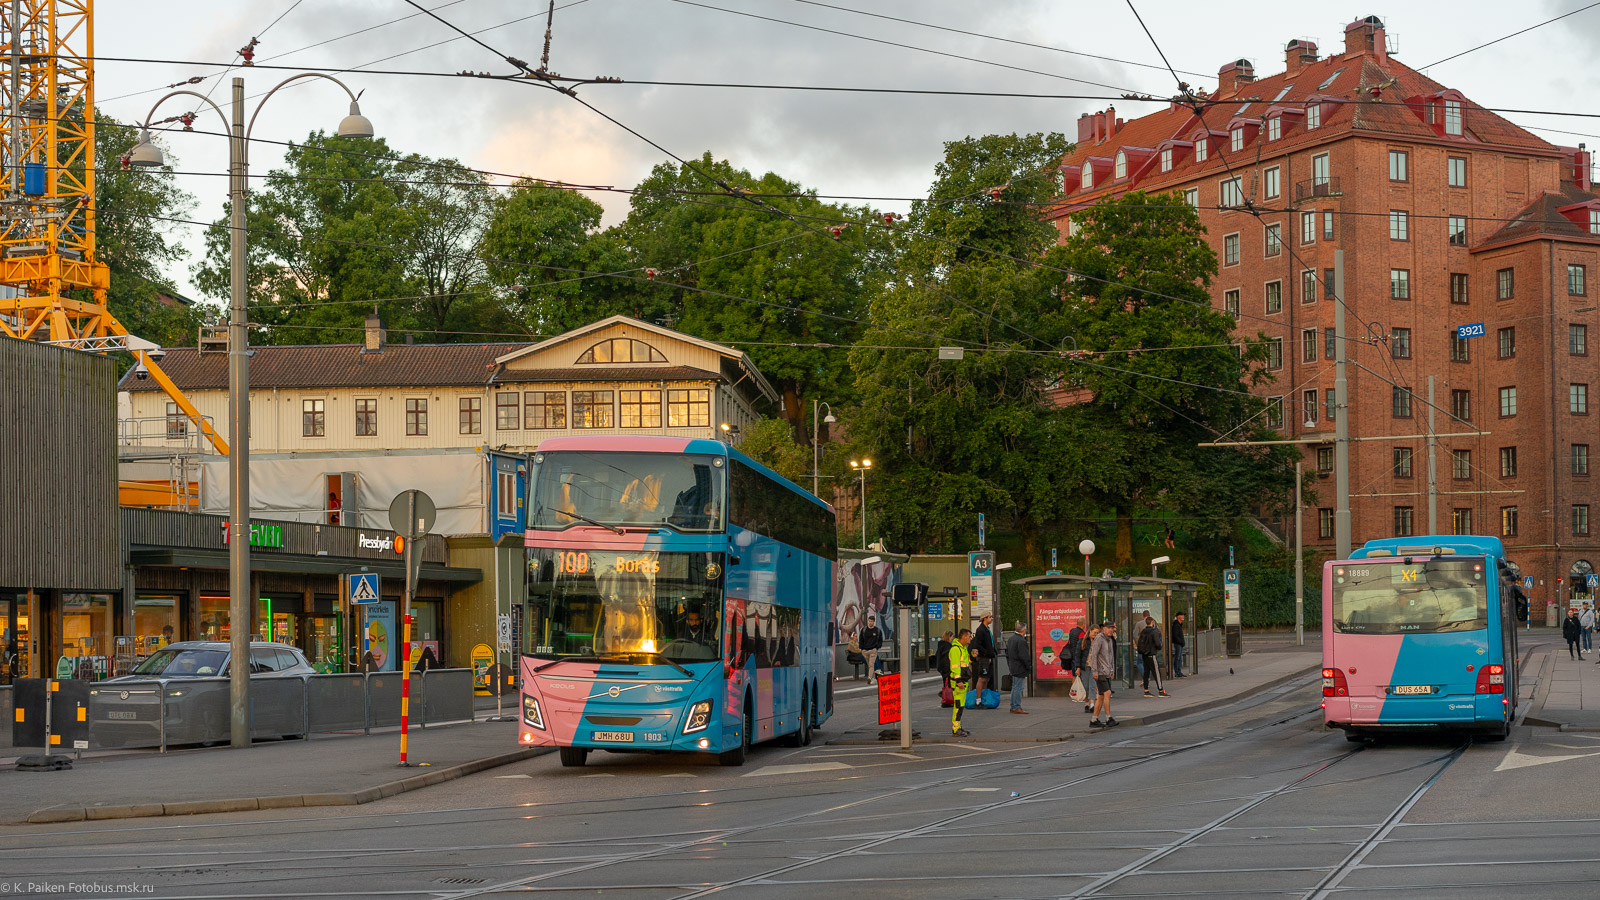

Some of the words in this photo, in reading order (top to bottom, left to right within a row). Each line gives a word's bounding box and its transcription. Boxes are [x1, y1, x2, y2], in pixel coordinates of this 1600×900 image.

[1460, 325, 1483, 336] 3921
[360, 534, 393, 552] Pressbyrån
[559, 552, 588, 574] 100
[616, 556, 660, 574] Borås
[974, 560, 987, 568] A3
[1401, 569, 1417, 582] X4
[644, 733, 662, 741] 1903
